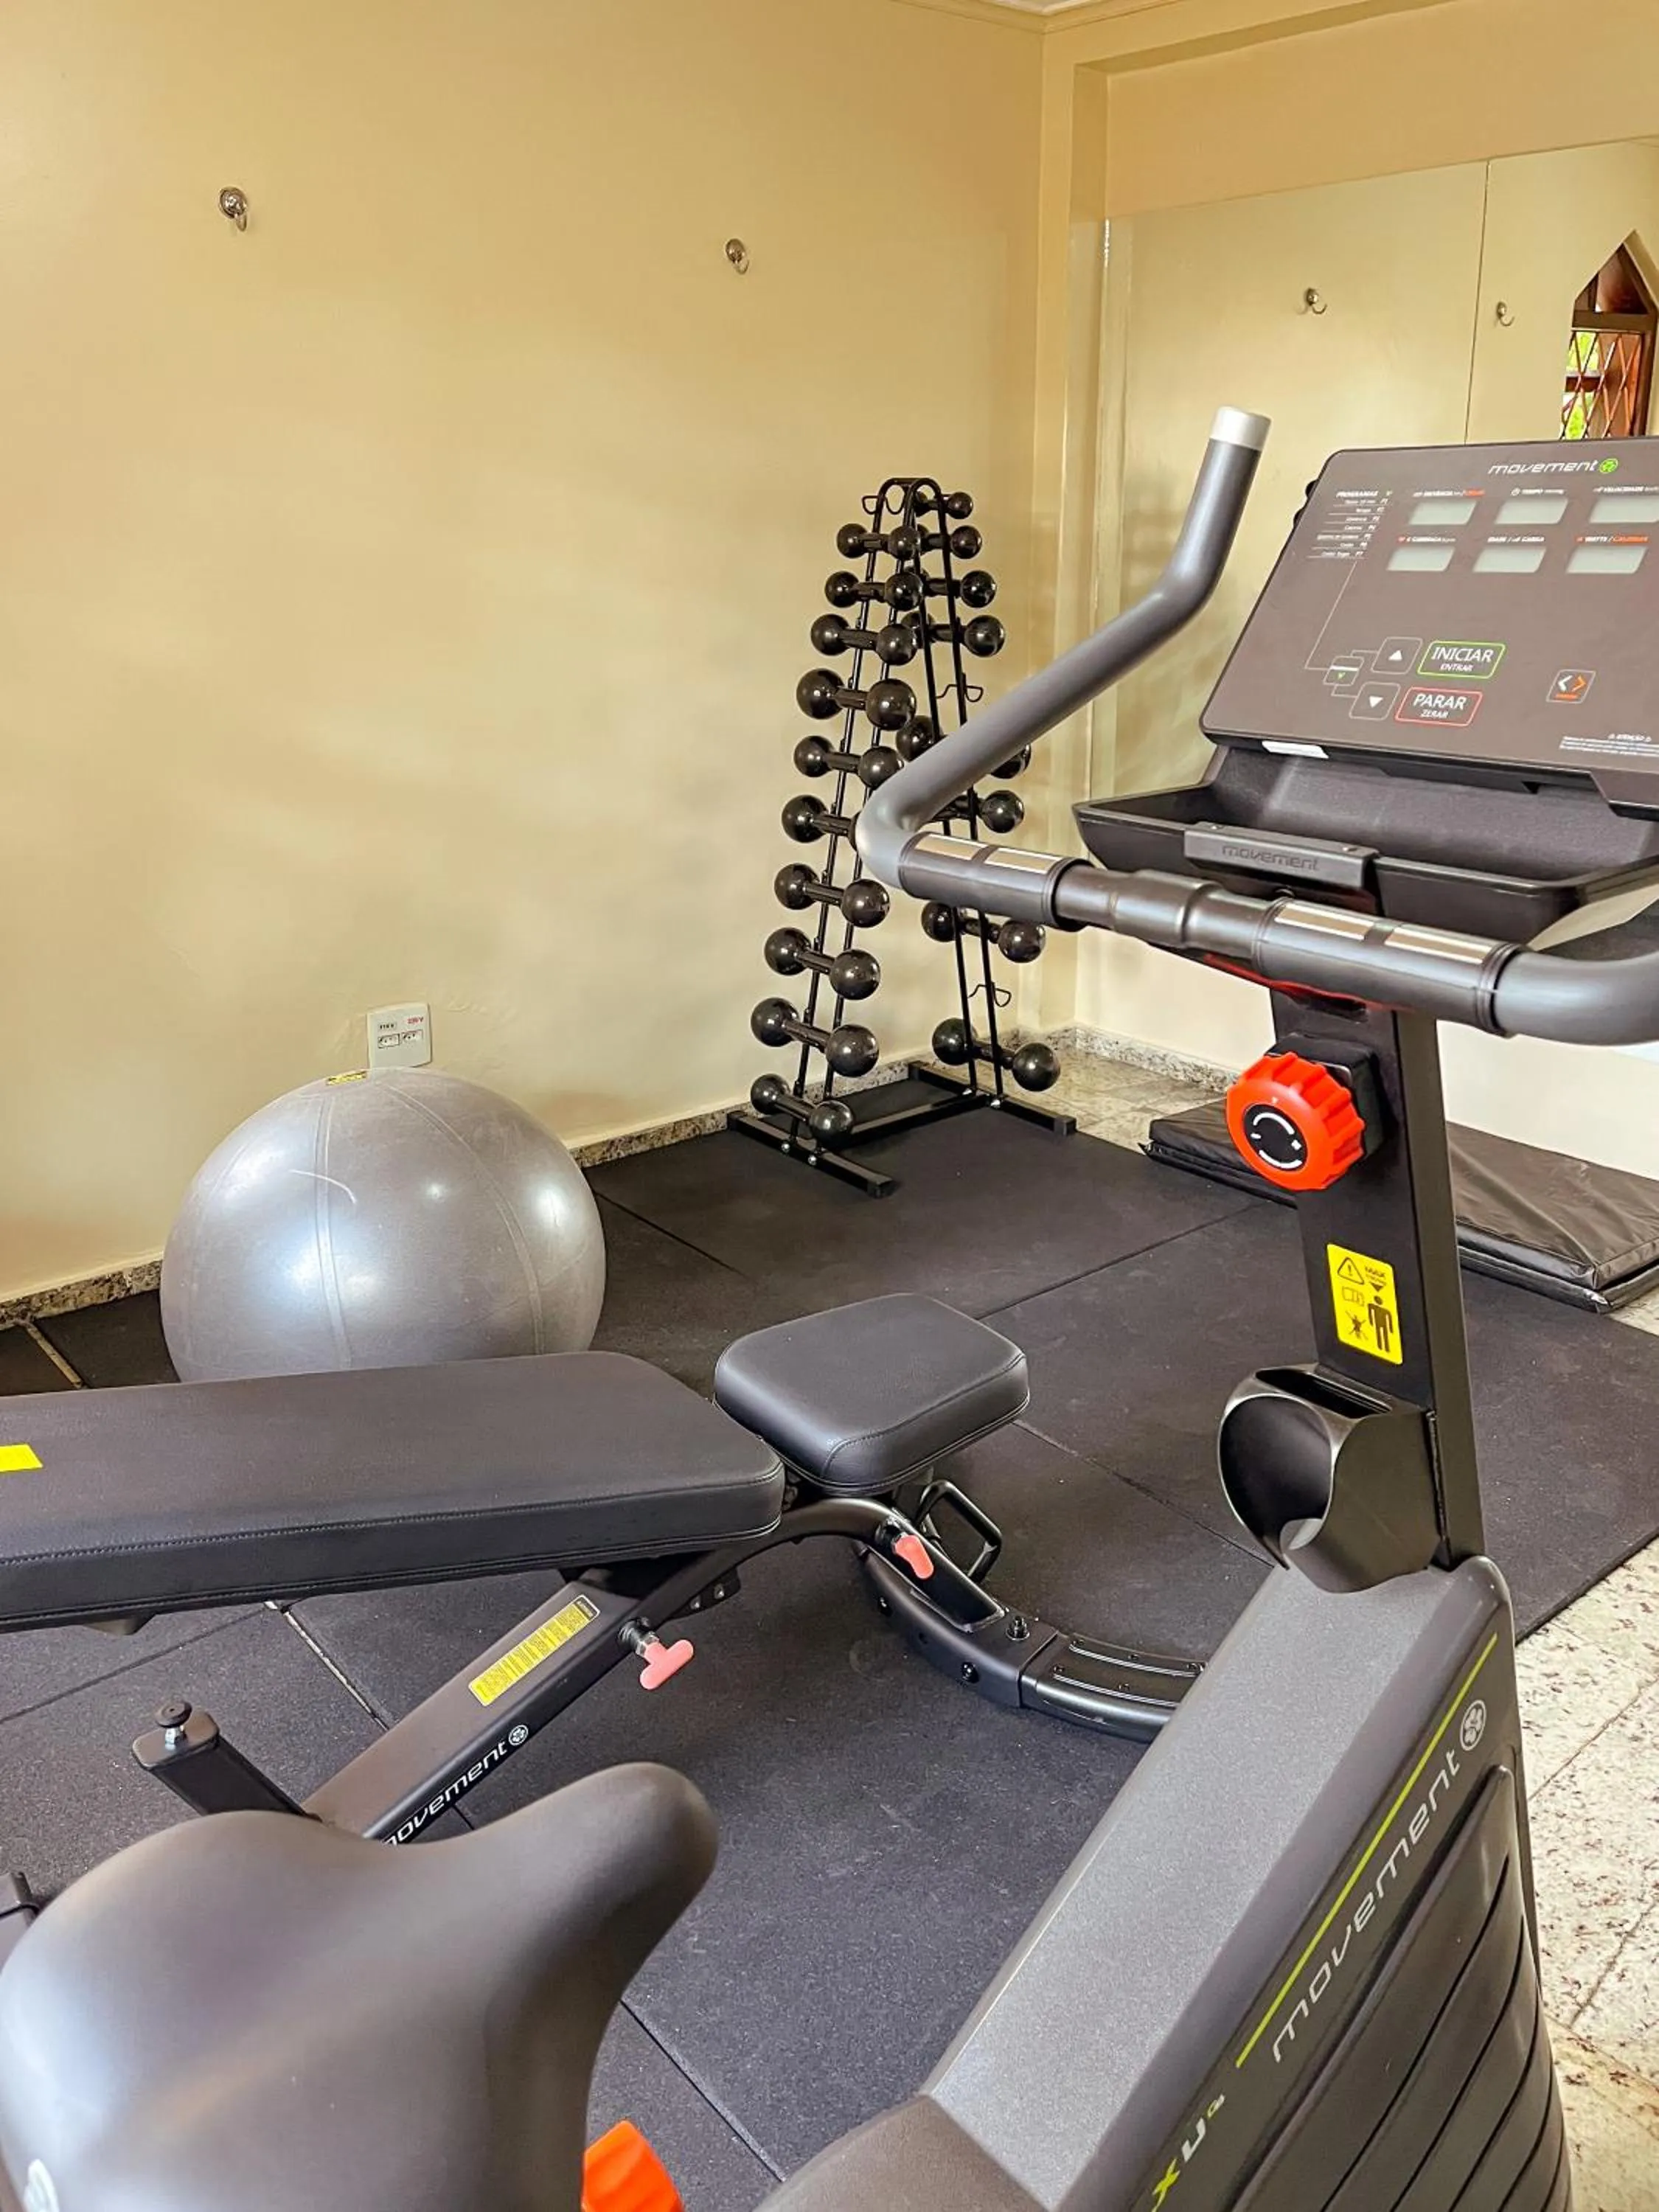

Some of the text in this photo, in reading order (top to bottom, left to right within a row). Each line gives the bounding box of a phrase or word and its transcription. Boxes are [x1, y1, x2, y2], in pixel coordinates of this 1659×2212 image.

[1488, 459, 1599, 474] movement
[1431, 647, 1494, 663] INICIAR
[1440, 663, 1473, 672] ENTRAR
[1413, 693, 1467, 710] PARAR
[1420, 709, 1449, 719] ZERAR
[1221, 845, 1321, 871] movement
[1272, 1748, 1461, 2064] movement
